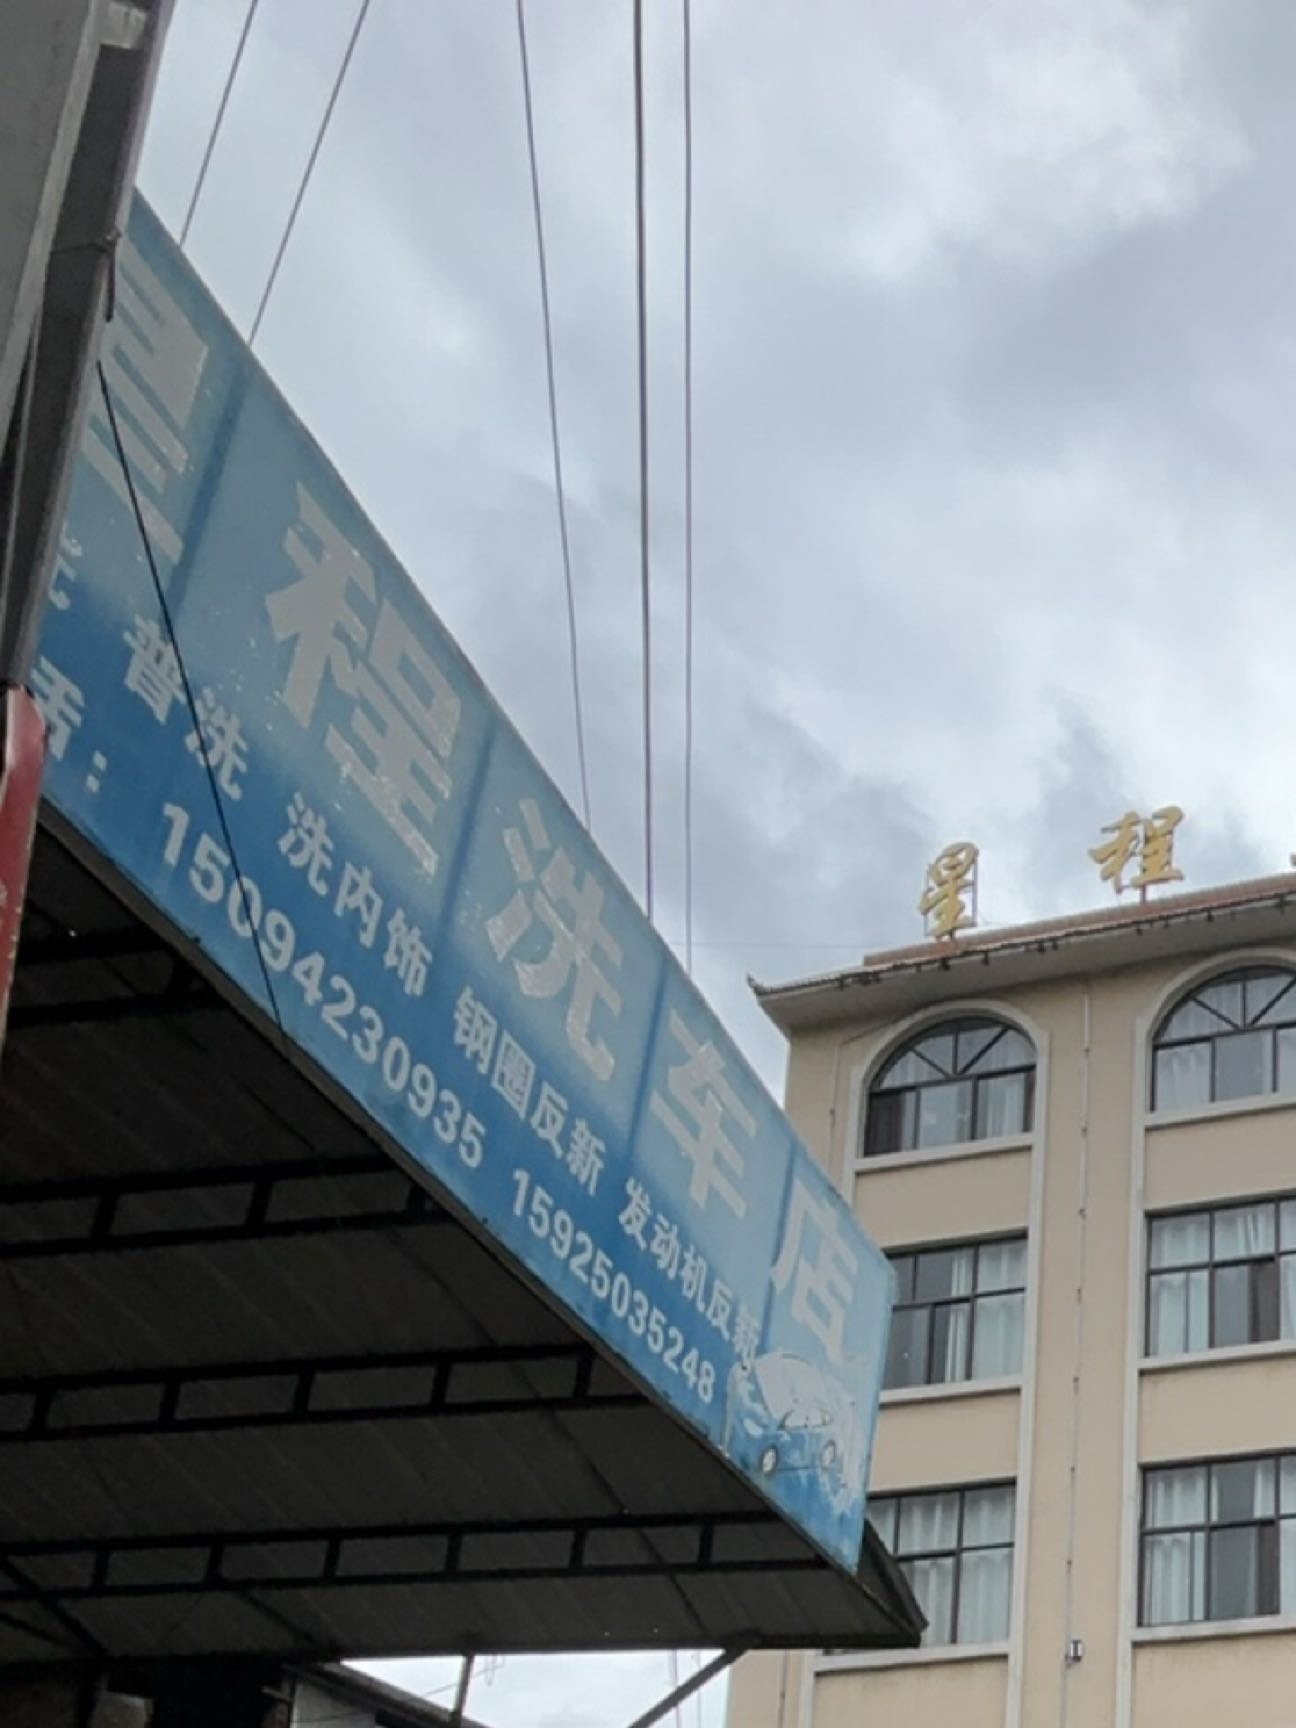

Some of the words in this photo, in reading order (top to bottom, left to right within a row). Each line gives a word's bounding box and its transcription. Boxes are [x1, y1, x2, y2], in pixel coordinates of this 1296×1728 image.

[123, 613, 248, 800] 普洗
[277, 792, 433, 997] 洗内饰
[454, 985, 607, 1196] 钢圈反新
[618, 1176, 760, 1372] 发动机反新
[163, 803, 486, 1169] 15094230935
[512, 1167, 716, 1404] 15925035248
